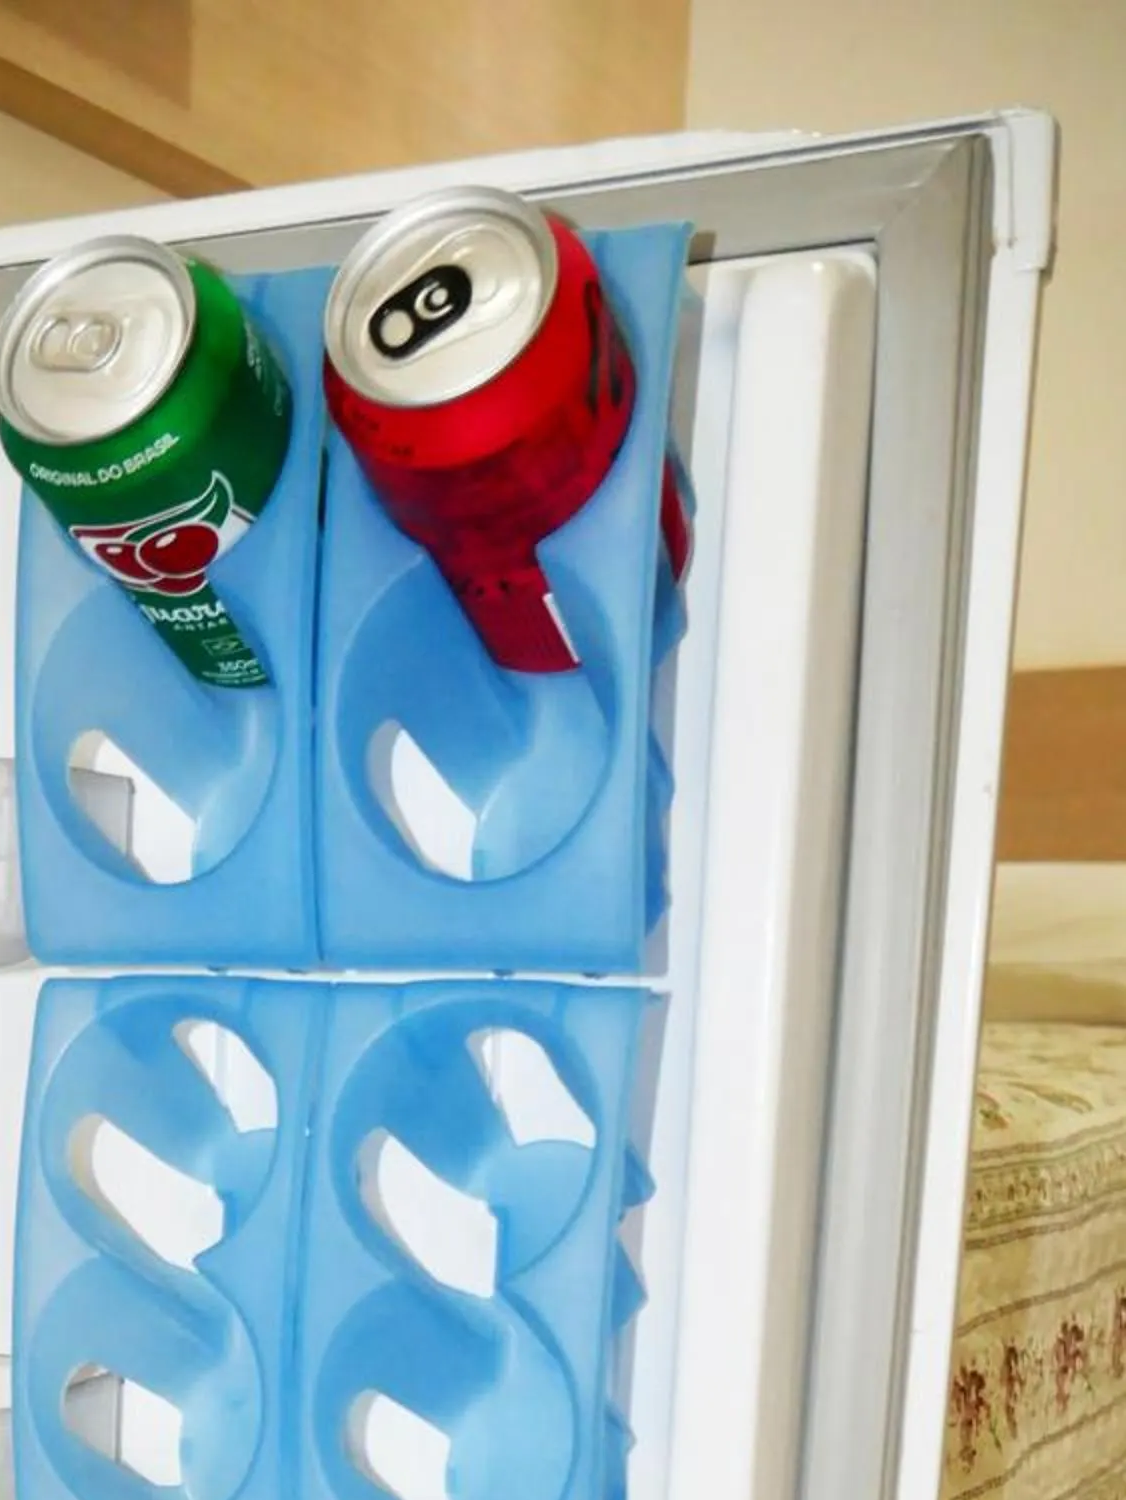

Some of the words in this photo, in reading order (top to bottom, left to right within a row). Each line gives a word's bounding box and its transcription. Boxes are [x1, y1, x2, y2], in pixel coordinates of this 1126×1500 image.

[29, 461, 98, 487] ORIGINAL
[97, 463, 123, 484] DO
[122, 432, 181, 475] BRASIL
